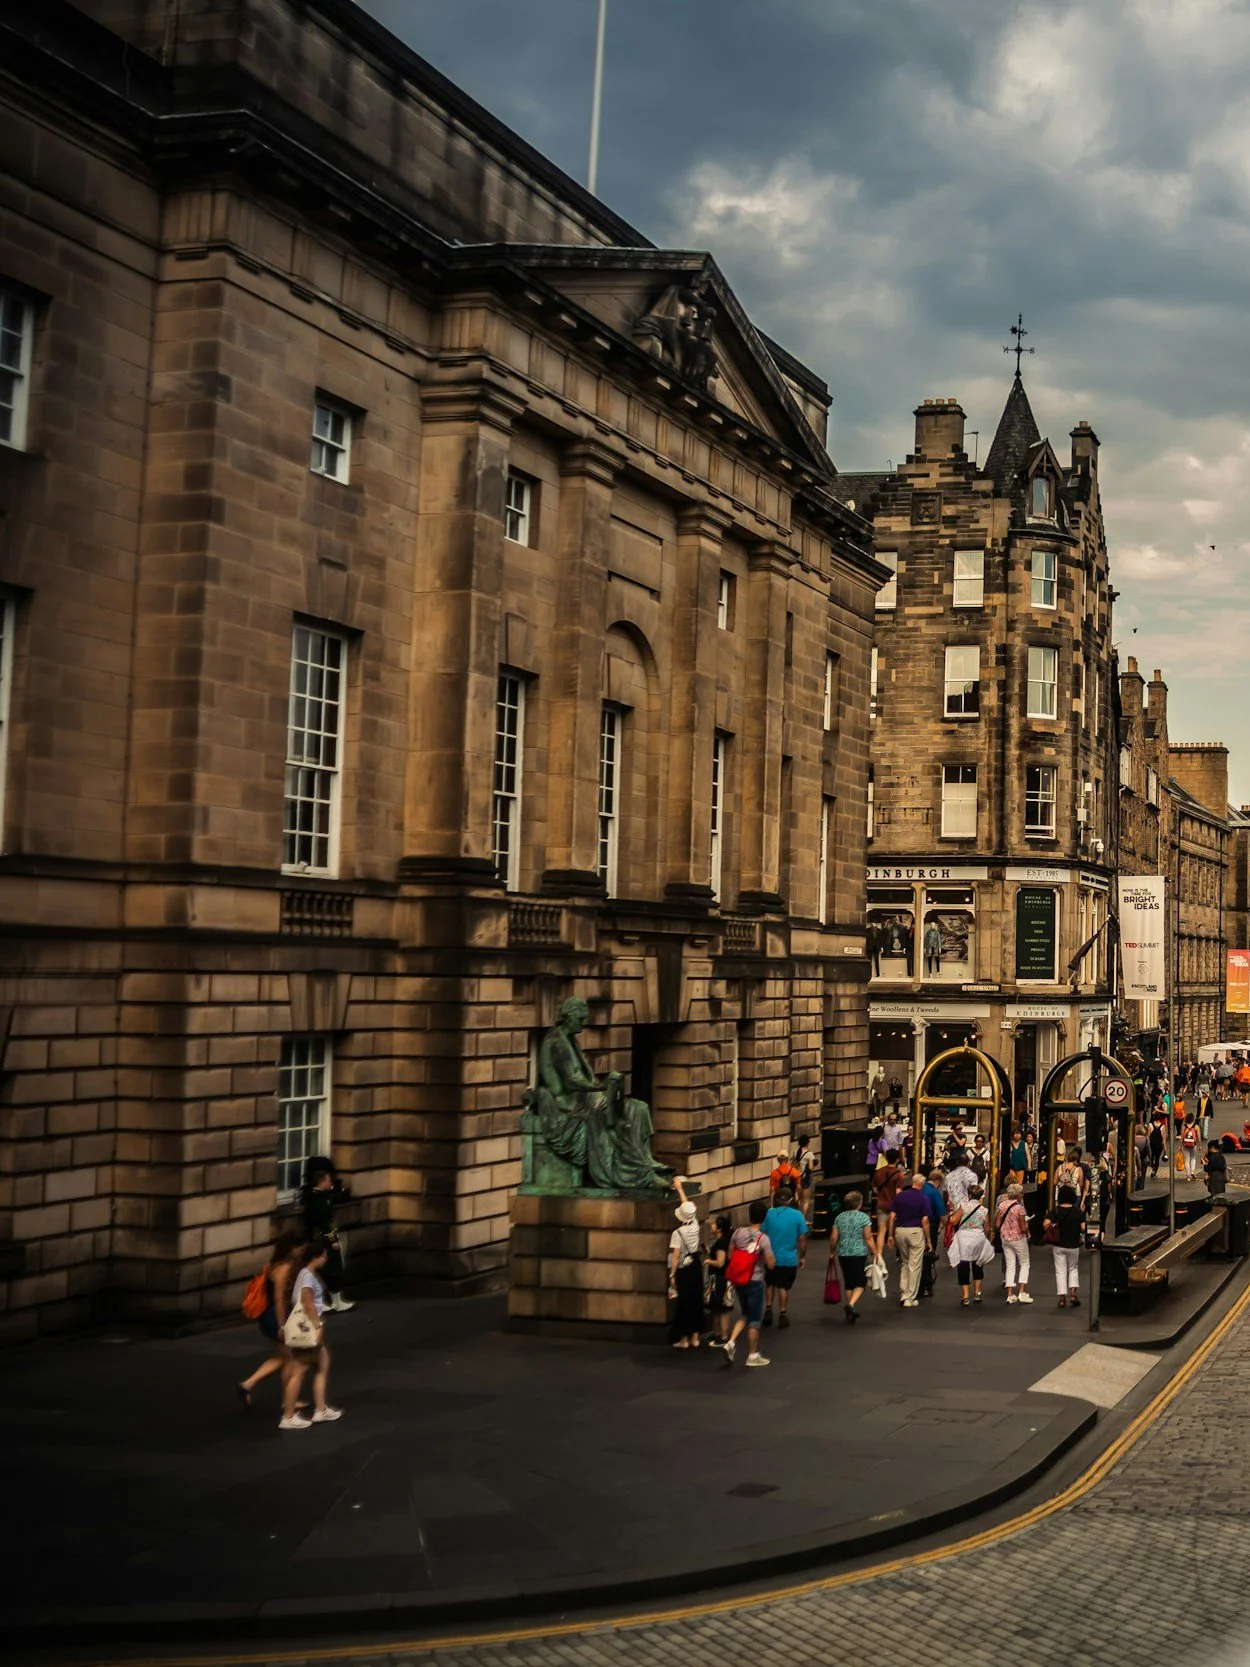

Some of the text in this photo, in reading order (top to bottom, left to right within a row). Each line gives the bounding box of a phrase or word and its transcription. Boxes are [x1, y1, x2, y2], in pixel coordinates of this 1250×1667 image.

[1123, 895, 1156, 903] BRIGHT
[1134, 902, 1160, 910] IDEAS
[1108, 1086, 1125, 1097] 20
